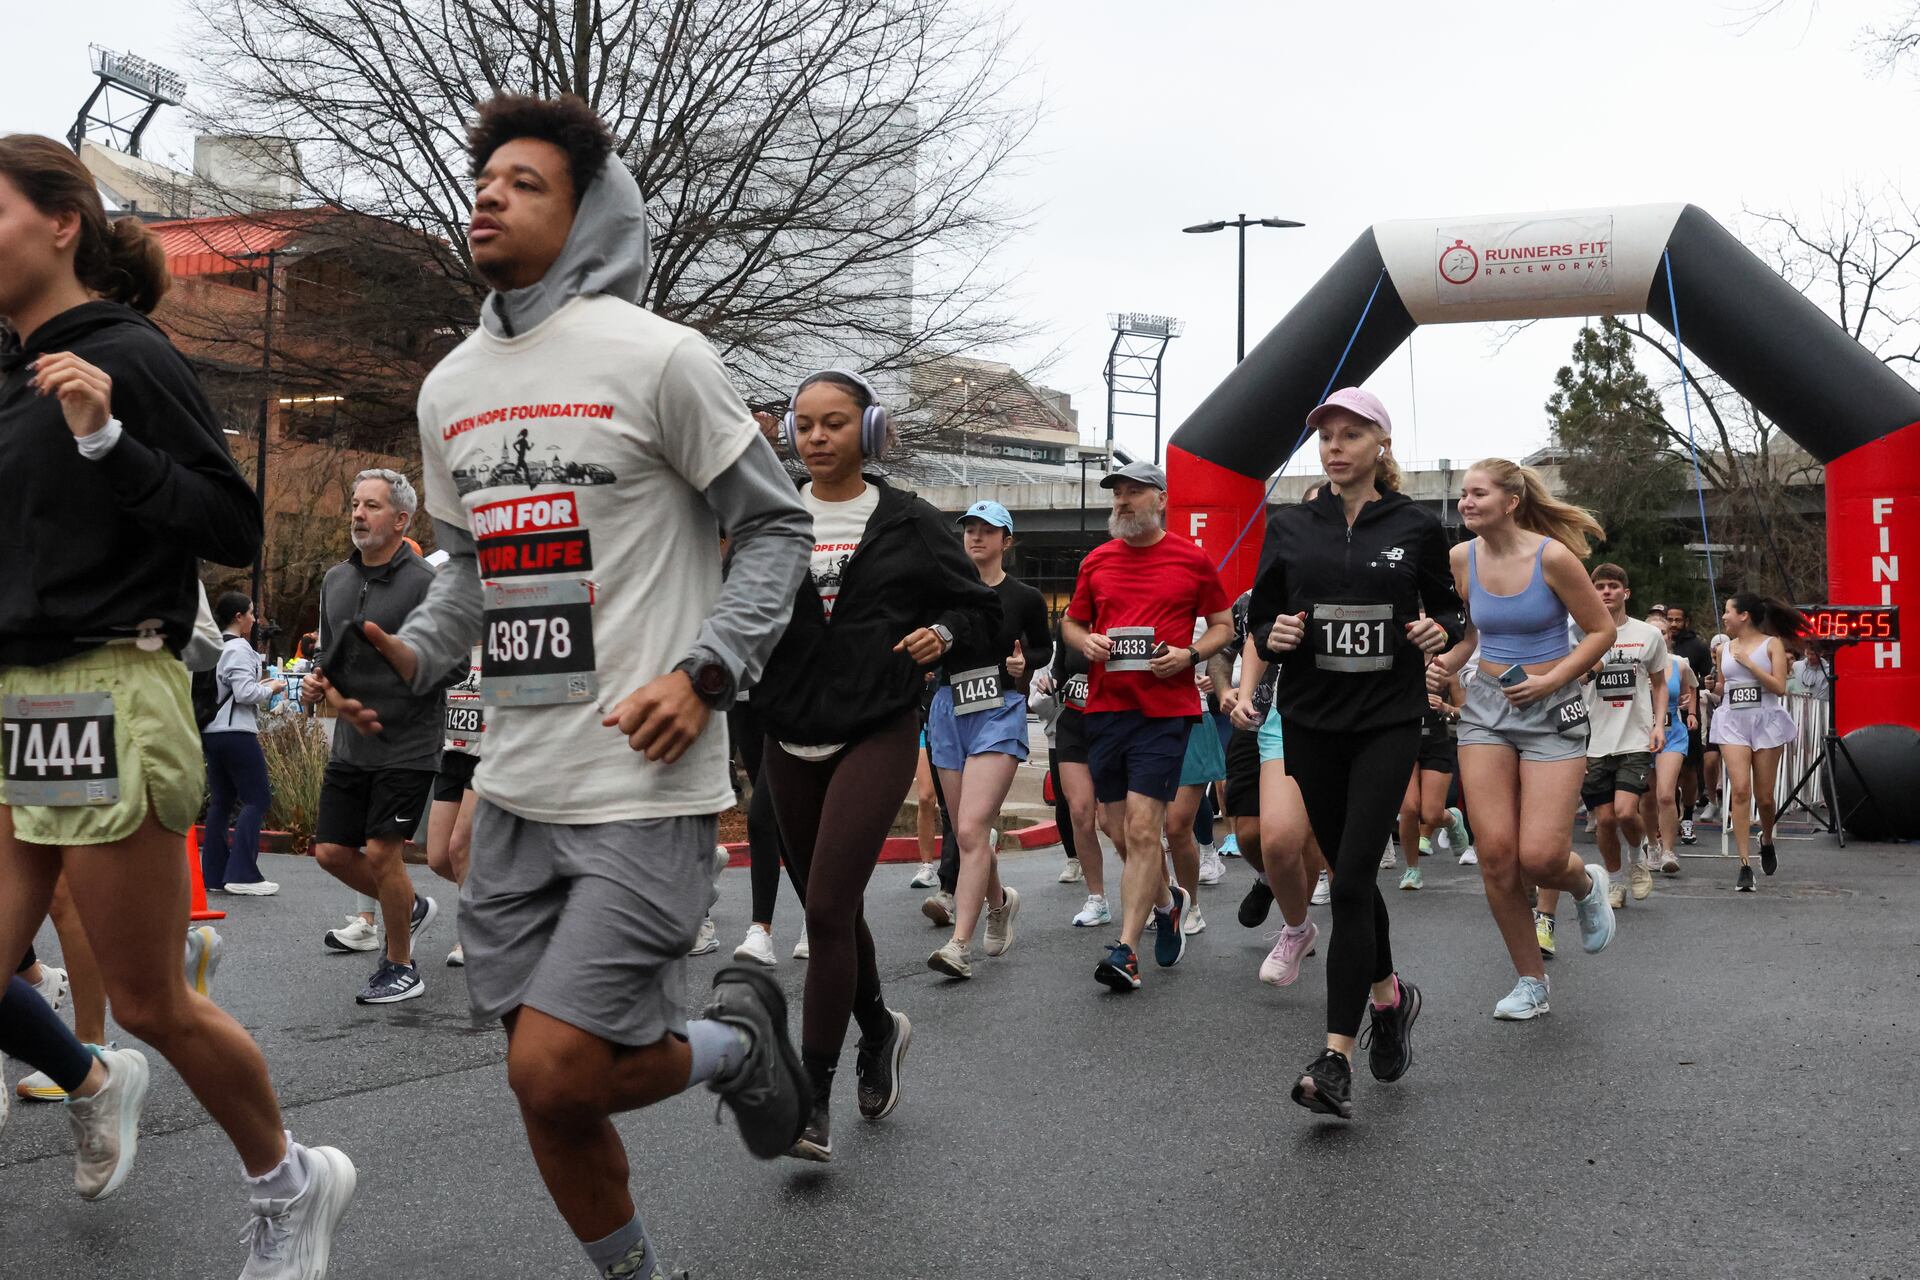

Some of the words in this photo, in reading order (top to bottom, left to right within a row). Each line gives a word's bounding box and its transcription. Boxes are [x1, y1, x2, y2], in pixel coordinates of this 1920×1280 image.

[1485, 243, 1573, 261] RUNNERS
[1579, 241, 1608, 255] FIT
[1485, 260, 1608, 276] RACEWORKS
[442, 415, 475, 441] LAKEN
[476, 408, 508, 428] HOPE
[509, 403, 615, 420] FOUNDATION
[473, 505, 513, 537] RUN
[516, 499, 573, 529] FOR
[520, 540, 583, 569] LIFE
[811, 544, 835, 552] OPE
[1872, 498, 1901, 668] FINIH
[488, 617, 572, 661] 43878
[1111, 639, 1146, 655] 44333
[1322, 622, 1384, 655] 1431
[956, 677, 998, 703] 1443
[1600, 673, 1629, 686] 44013
[1732, 688, 1757, 702] 4939
[447, 708, 479, 731] 1428
[3, 721, 105, 776] 7444
